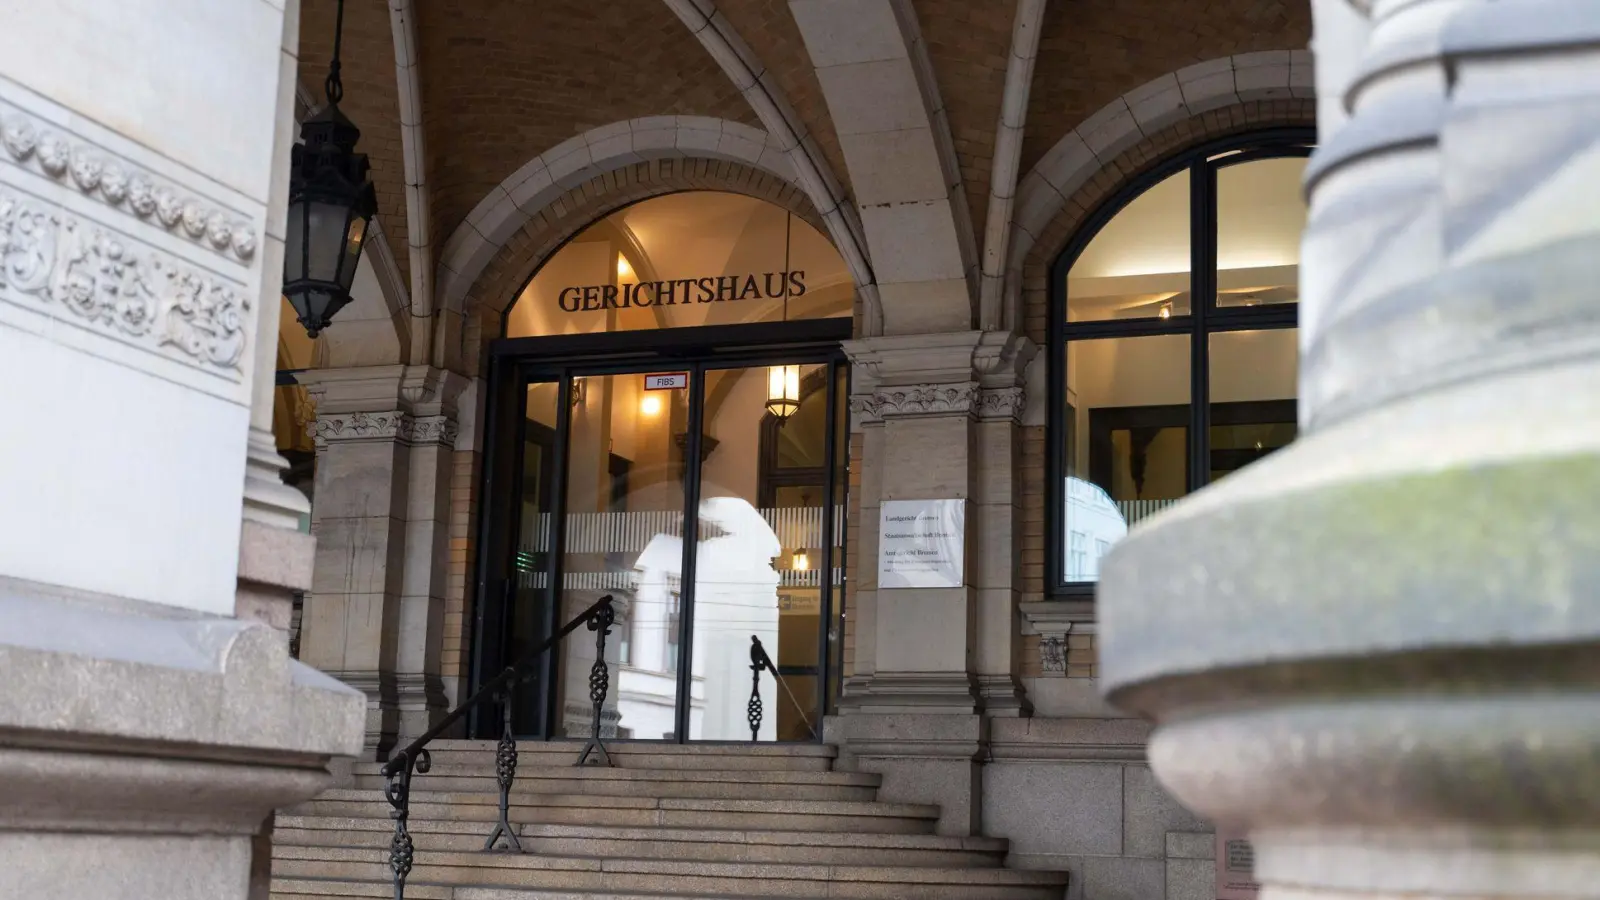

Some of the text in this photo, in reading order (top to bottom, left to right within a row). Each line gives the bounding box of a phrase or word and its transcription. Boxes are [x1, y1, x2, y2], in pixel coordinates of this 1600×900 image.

[558, 270, 806, 312] GERICHTSHAUS
[657, 377, 675, 387] FIBS
[884, 531, 933, 539] Staatsanwahaft
[884, 549, 916, 557] Amticht
